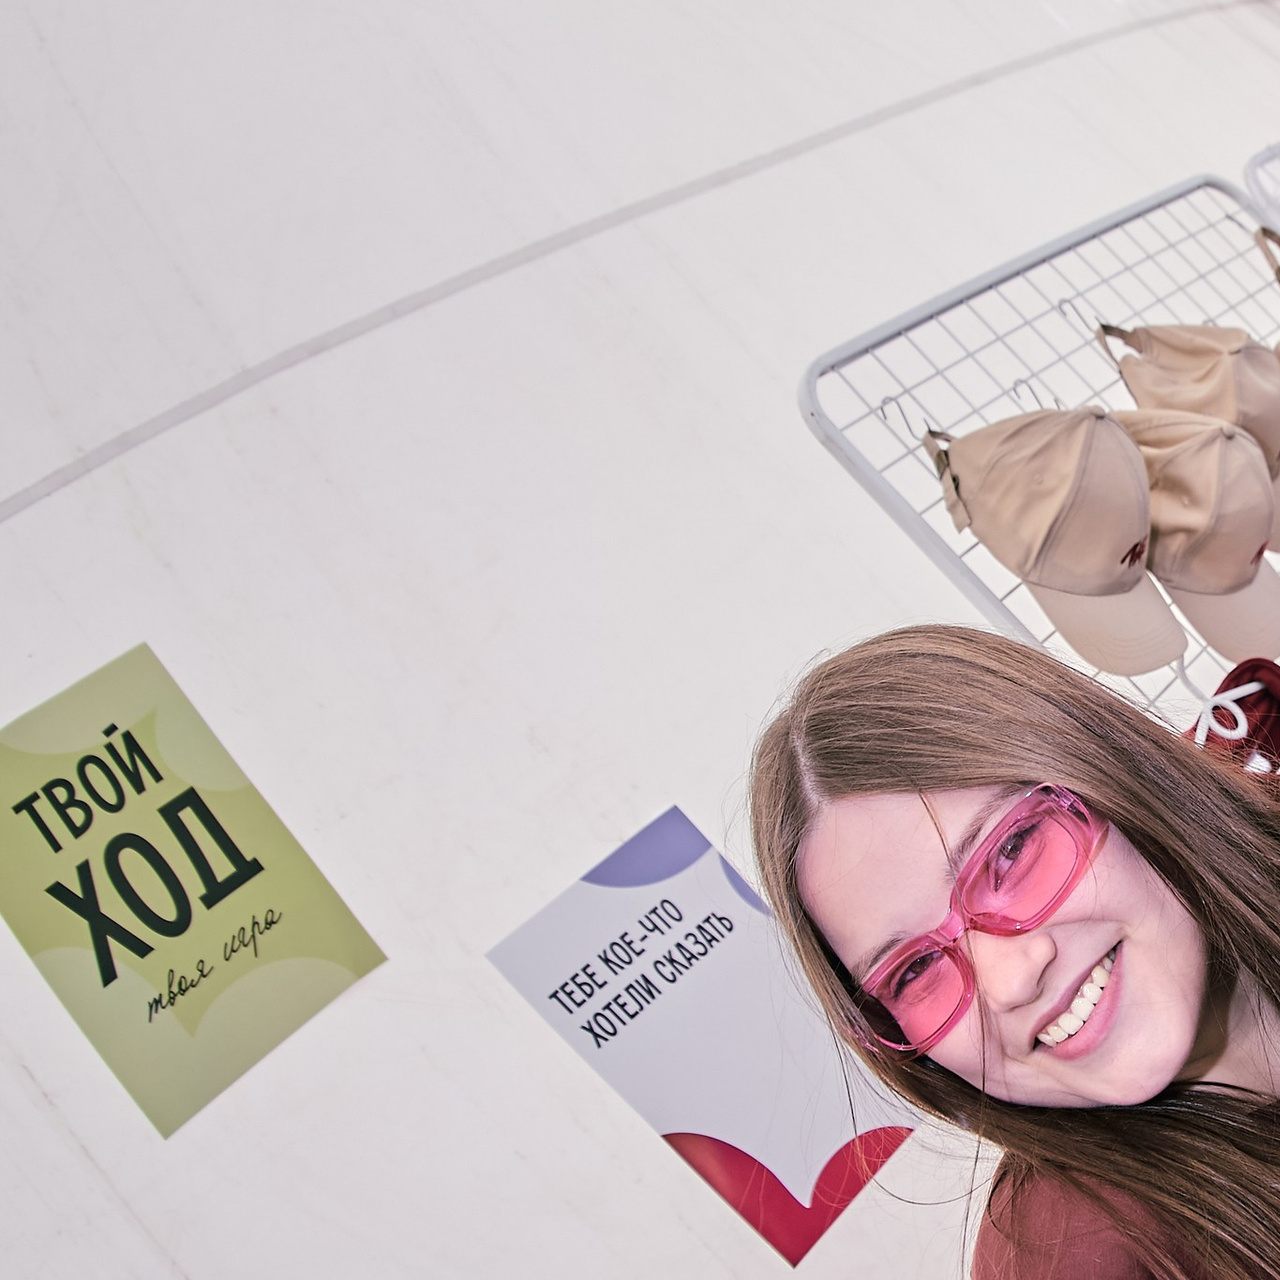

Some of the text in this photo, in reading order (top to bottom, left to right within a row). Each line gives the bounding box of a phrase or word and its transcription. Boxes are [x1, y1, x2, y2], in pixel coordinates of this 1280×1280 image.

[11, 723, 164, 853] ТВОЙ
[45, 786, 265, 988] ХОД
[148, 908, 283, 1023] твоя игра
[548, 898, 683, 1015] ТЕБЕ КОЕ-ЧТО
[580, 912, 735, 1049] ХОТЕЛИ СКАЗАТЬ
